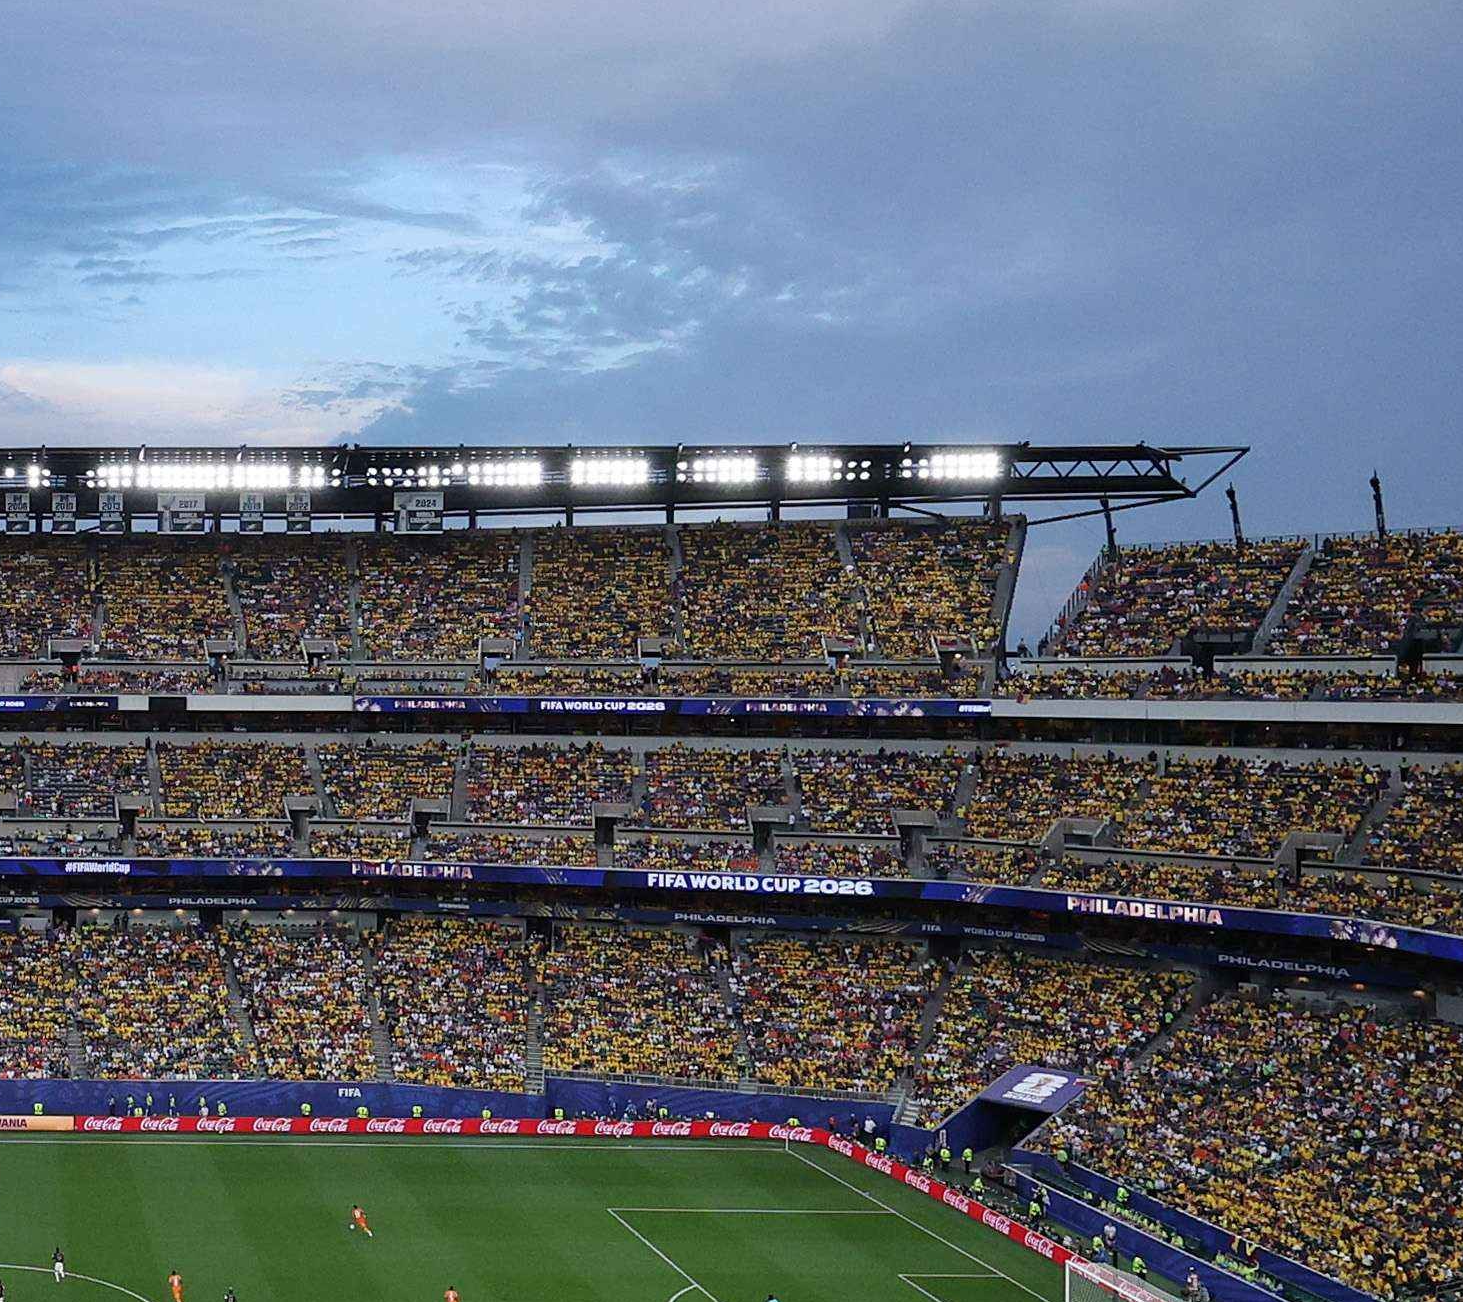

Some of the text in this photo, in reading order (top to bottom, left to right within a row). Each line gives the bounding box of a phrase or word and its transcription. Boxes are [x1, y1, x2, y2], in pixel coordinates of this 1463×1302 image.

[178, 499, 198, 508] 2017
[394, 700, 466, 710] PHILADELPHIA
[541, 701, 665, 711] FIFA WORLD CUP 2026
[746, 703, 827, 713] PHILADELPHIA
[65, 862, 131, 875] #FIFAWorldCup
[351, 863, 473, 880] PHILADELPHIA
[647, 873, 873, 896] FIFA WORLD CUP 2026
[168, 897, 257, 906] PHILADELPHIA
[674, 912, 777, 926] PHILADELPHIA
[1067, 896, 1223, 926] PHILADELPHIA
[921, 923, 1014, 940] FIFA WORLD CUP
[1218, 953, 1350, 978] PHILADELPHIA
[338, 1087, 362, 1098] FIFA
[83, 1116, 123, 1131] Coca-Cola
[140, 1116, 179, 1132] Coca-Cola
[197, 1117, 235, 1133] Coca-Cola
[253, 1117, 292, 1133] Coca-Cola
[309, 1117, 348, 1133] Coca-Cola
[366, 1118, 405, 1134] Coca-Cola
[423, 1118, 462, 1134] Coca-Cola
[479, 1119, 519, 1135] Coca-Cola
[537, 1120, 577, 1136] Coca-Cola
[594, 1121, 634, 1138] Coca-Cola
[651, 1121, 692, 1136] Coca-Cola
[709, 1122, 750, 1137] Coca-Cola
[769, 1124, 813, 1142] Coca-Cola
[826, 1134, 853, 1157] Coca-Cola
[865, 1152, 893, 1175] Coca-Cola
[904, 1170, 931, 1195] Coca-Cola
[942, 1189, 970, 1215] Coca-Cola
[982, 1209, 1010, 1236] Coca-Cola
[1024, 1230, 1054, 1259] Coca-Cola
